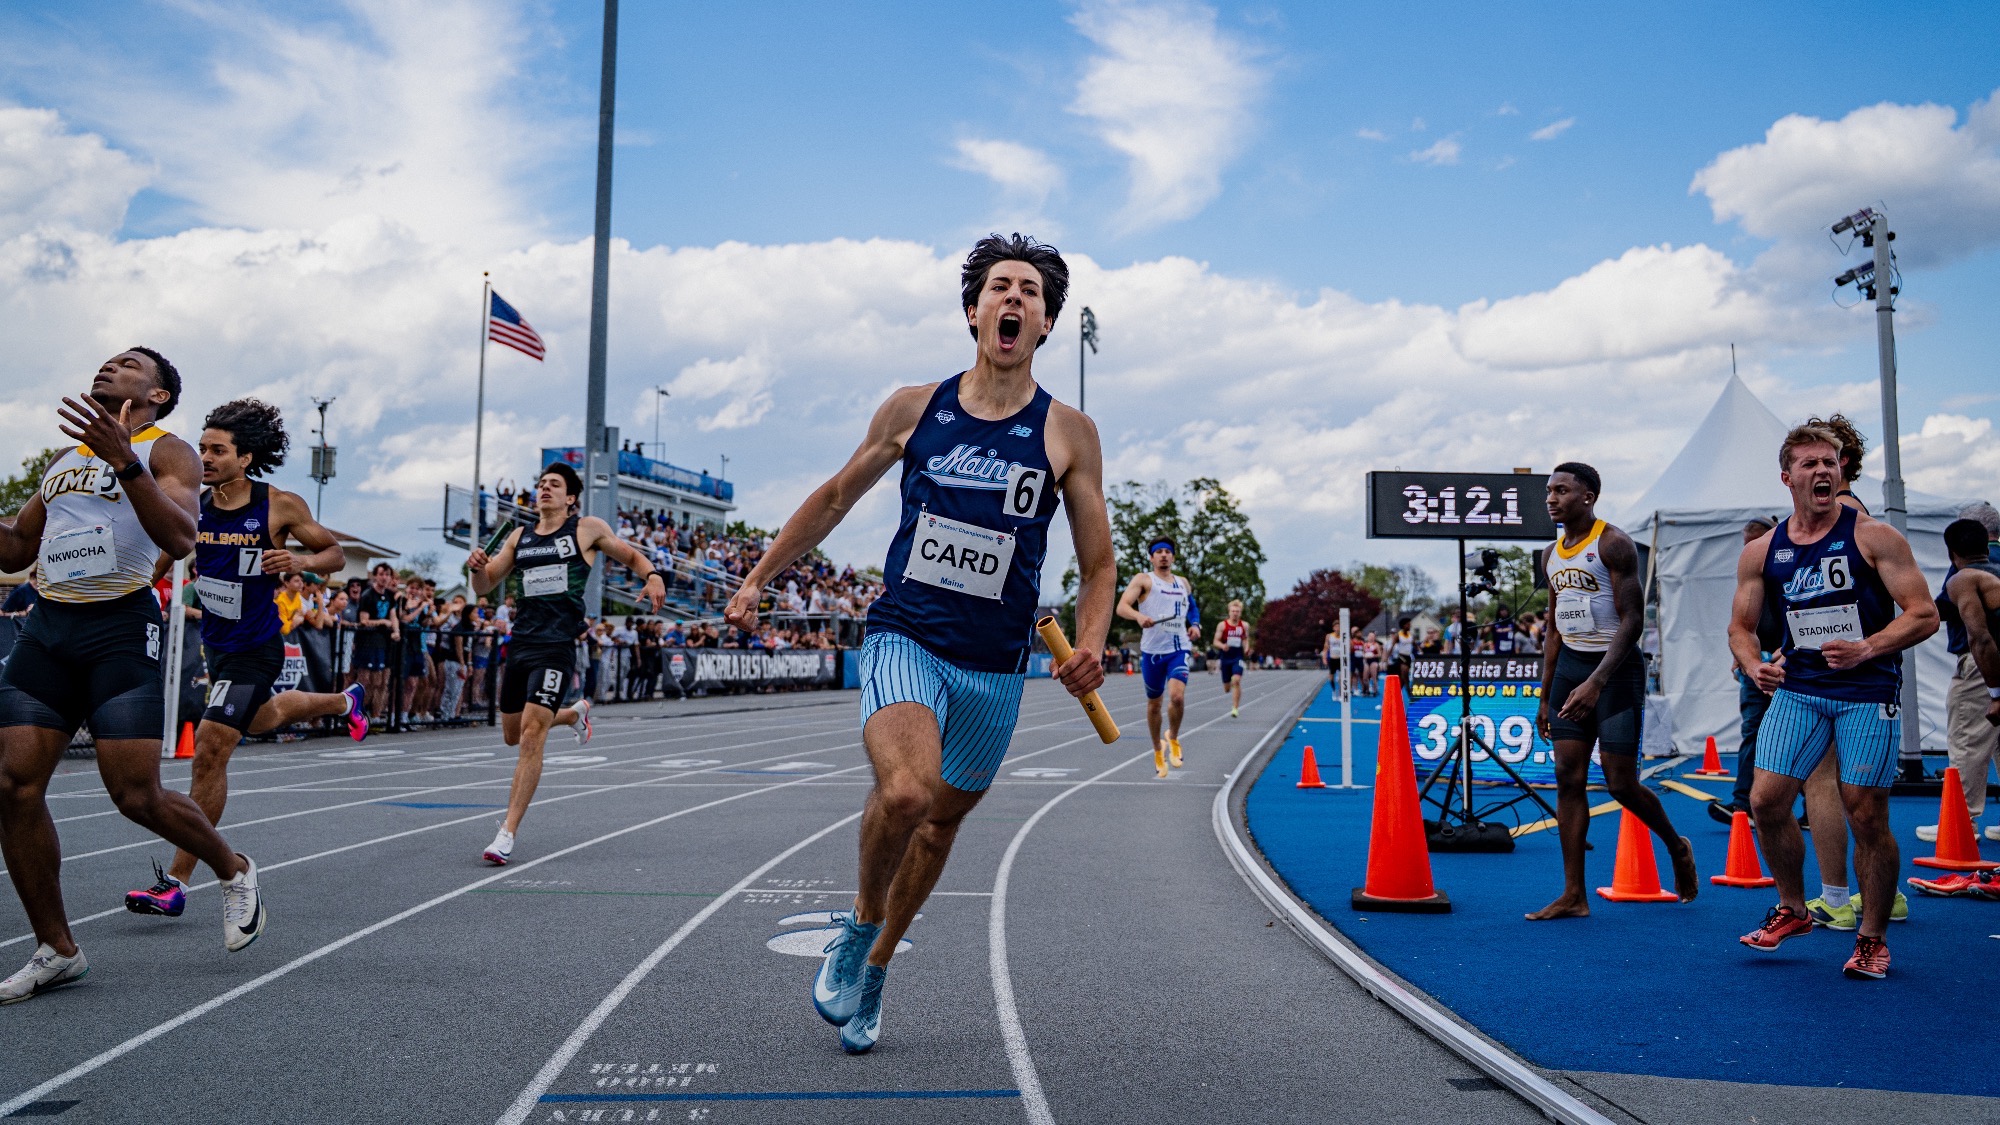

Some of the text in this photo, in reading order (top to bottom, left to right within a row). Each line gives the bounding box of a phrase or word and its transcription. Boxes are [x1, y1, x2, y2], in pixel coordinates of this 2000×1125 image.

[43, 466, 121, 503] UMB
[101, 464, 116, 492] 5
[1013, 470, 1038, 514] 6
[1402, 484, 1523, 524] 3:12.1
[47, 545, 106, 563] NKWOCHA
[516, 547, 560, 559] BINGHAMT
[560, 538, 571, 555] 3
[245, 550, 258, 574] 7
[921, 538, 999, 576] CARD
[940, 576, 964, 589] Maine
[1828, 558, 1845, 589] 6
[198, 589, 234, 604] MARTINEZ
[1799, 623, 1853, 637] STADNICKI
[278, 671, 297, 682] AST
[1414, 660, 1539, 679] 2026 Aerica East
[547, 671, 558, 689] 3
[212, 682, 226, 704] 7
[1411, 684, 1442, 697] Men
[1502, 685, 1516, 696] M
[1523, 685, 1542, 697] Re
[1415, 713, 1601, 764] 3:09.
